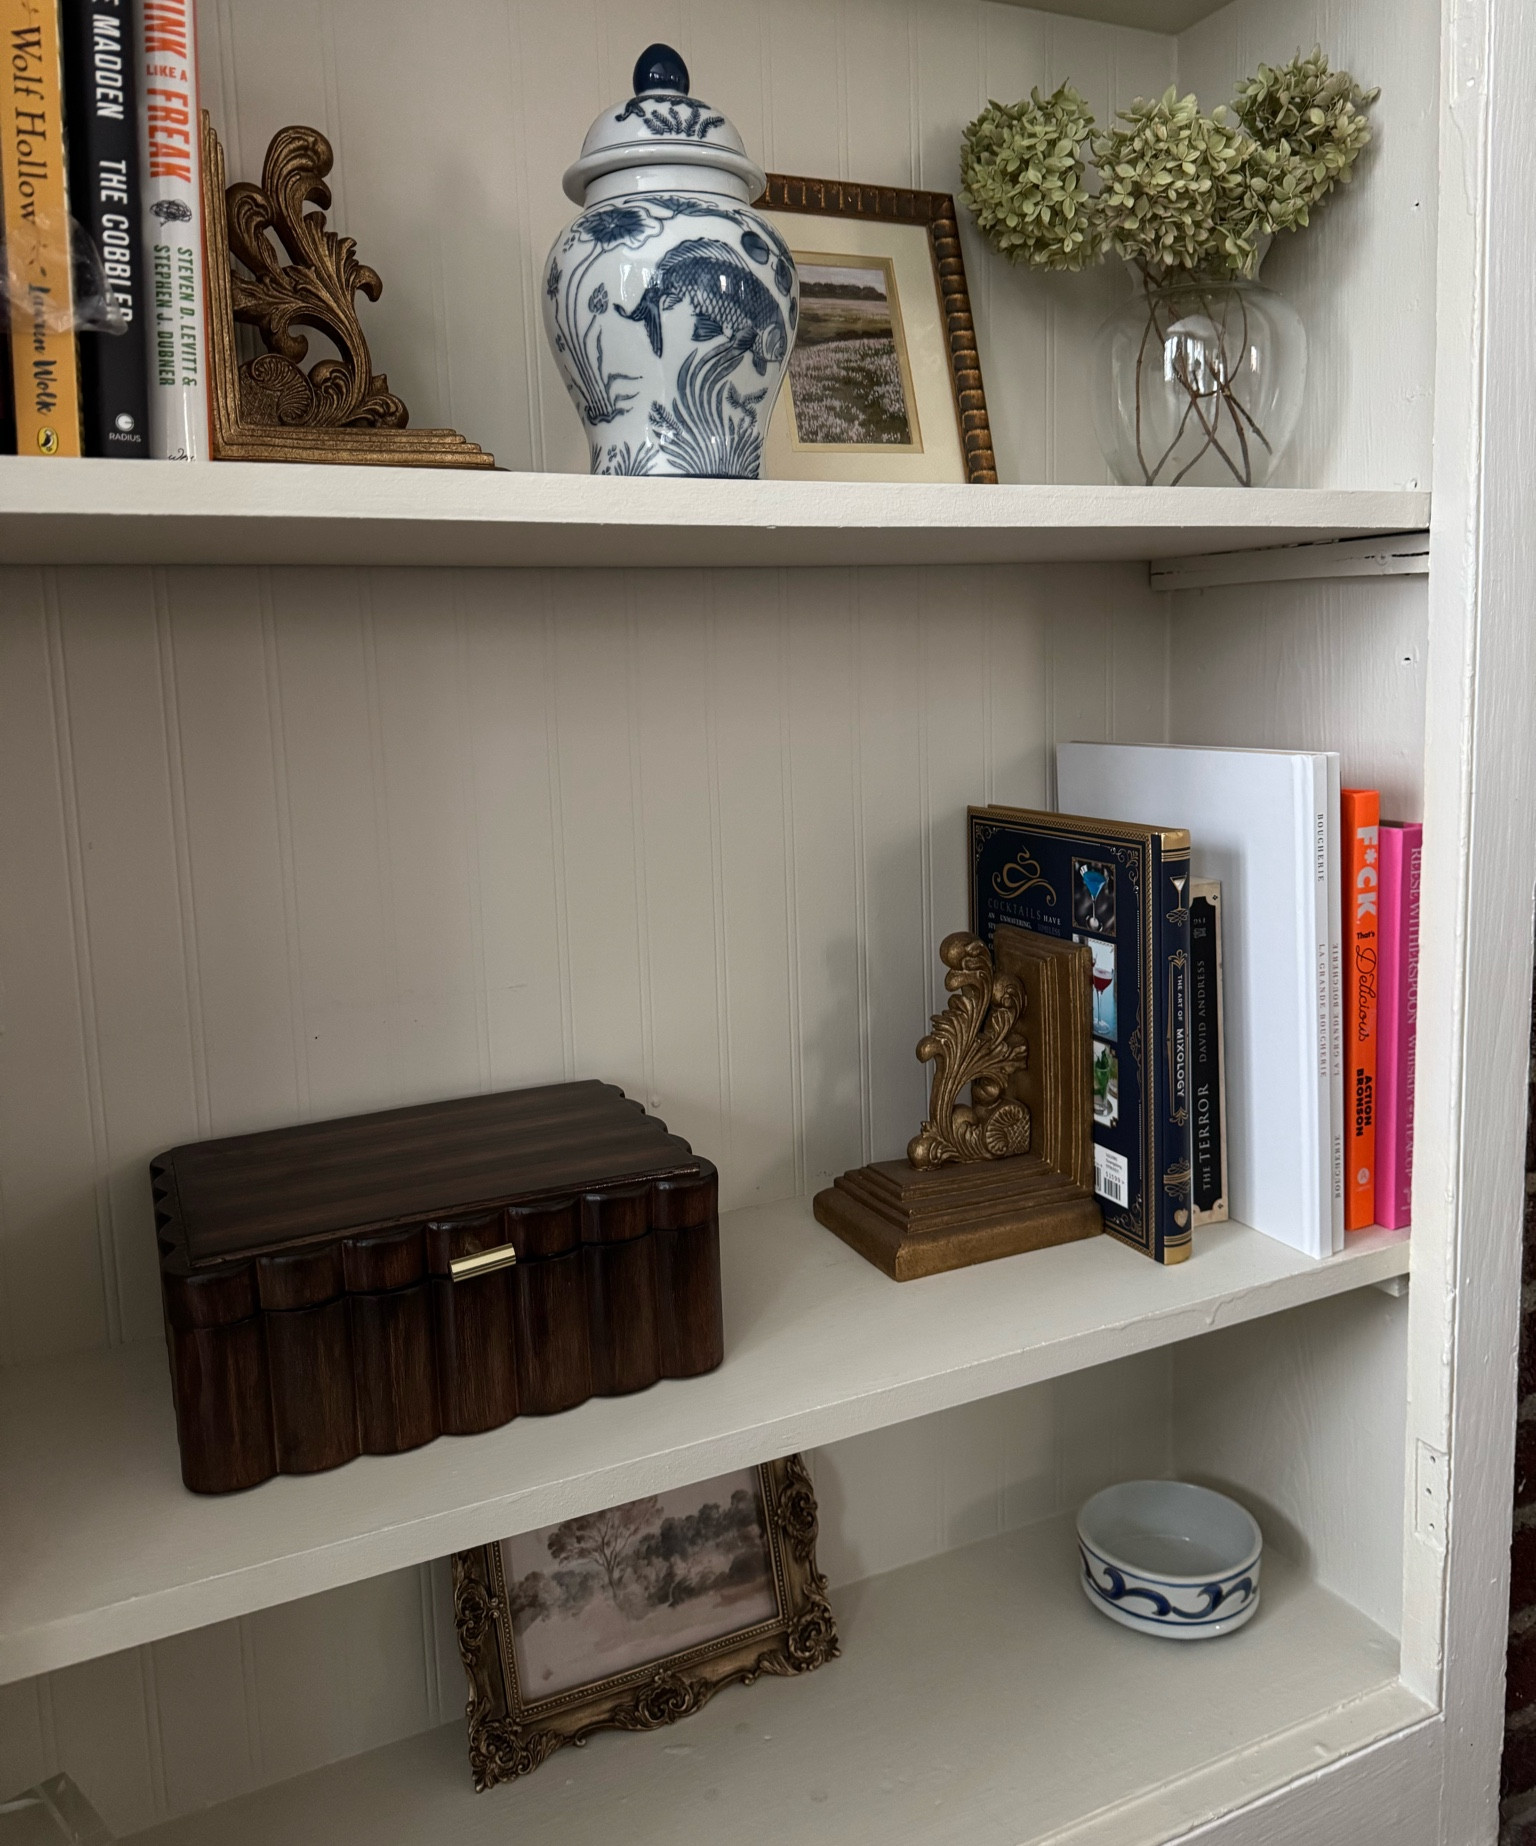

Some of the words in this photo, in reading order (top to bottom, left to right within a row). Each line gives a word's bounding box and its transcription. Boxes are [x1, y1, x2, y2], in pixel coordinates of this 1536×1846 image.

[143, 0, 188, 60] INK
[11, 26, 44, 101] Wolf
[92, 14, 124, 120] MADDEN
[146, 64, 177, 79] LIKE
[180, 69, 188, 82] A
[147, 88, 191, 184] FREAK
[15, 107, 48, 225] Hollow
[99, 160, 128, 205] THE
[154, 244, 174, 309] STEPHEN
[177, 247, 195, 301] STEVEN
[156, 312, 174, 326] J.
[180, 306, 195, 320] D.
[157, 331, 176, 386] DUBNER
[180, 325, 197, 374] LEVITT
[32, 360, 58, 416] Wolk
[182, 377, 198, 387] &
[108, 431, 141, 443] RADIUS
[1317, 813, 1325, 883] BOUCHERIE
[1408, 847, 1422, 900] REESE
[987, 897, 1041, 920] COCKTAILS
[1043, 914, 1062, 926] HAVE
[1356, 931, 1376, 940] That's
[1318, 943, 1326, 958] LA
[1406, 901, 1420, 1025] WITHERSPOON
[1196, 960, 1208, 1017] ANDRESS
[1319, 962, 1327, 1009] GRANDE
[1355, 944, 1378, 1042] Delicious
[1177, 1010, 1184, 1022] OF
[1198, 1022, 1208, 1063] DAVID
[1176, 1028, 1186, 1097] MIXOLOGY
[1319, 1013, 1328, 1078] BOUCHERIE
[1197, 1083, 1212, 1164] TERROR
[1355, 1068, 1365, 1138] BRONSON
[1363, 1074, 1373, 1127] ACTION
[1203, 1165, 1212, 1191] THE
